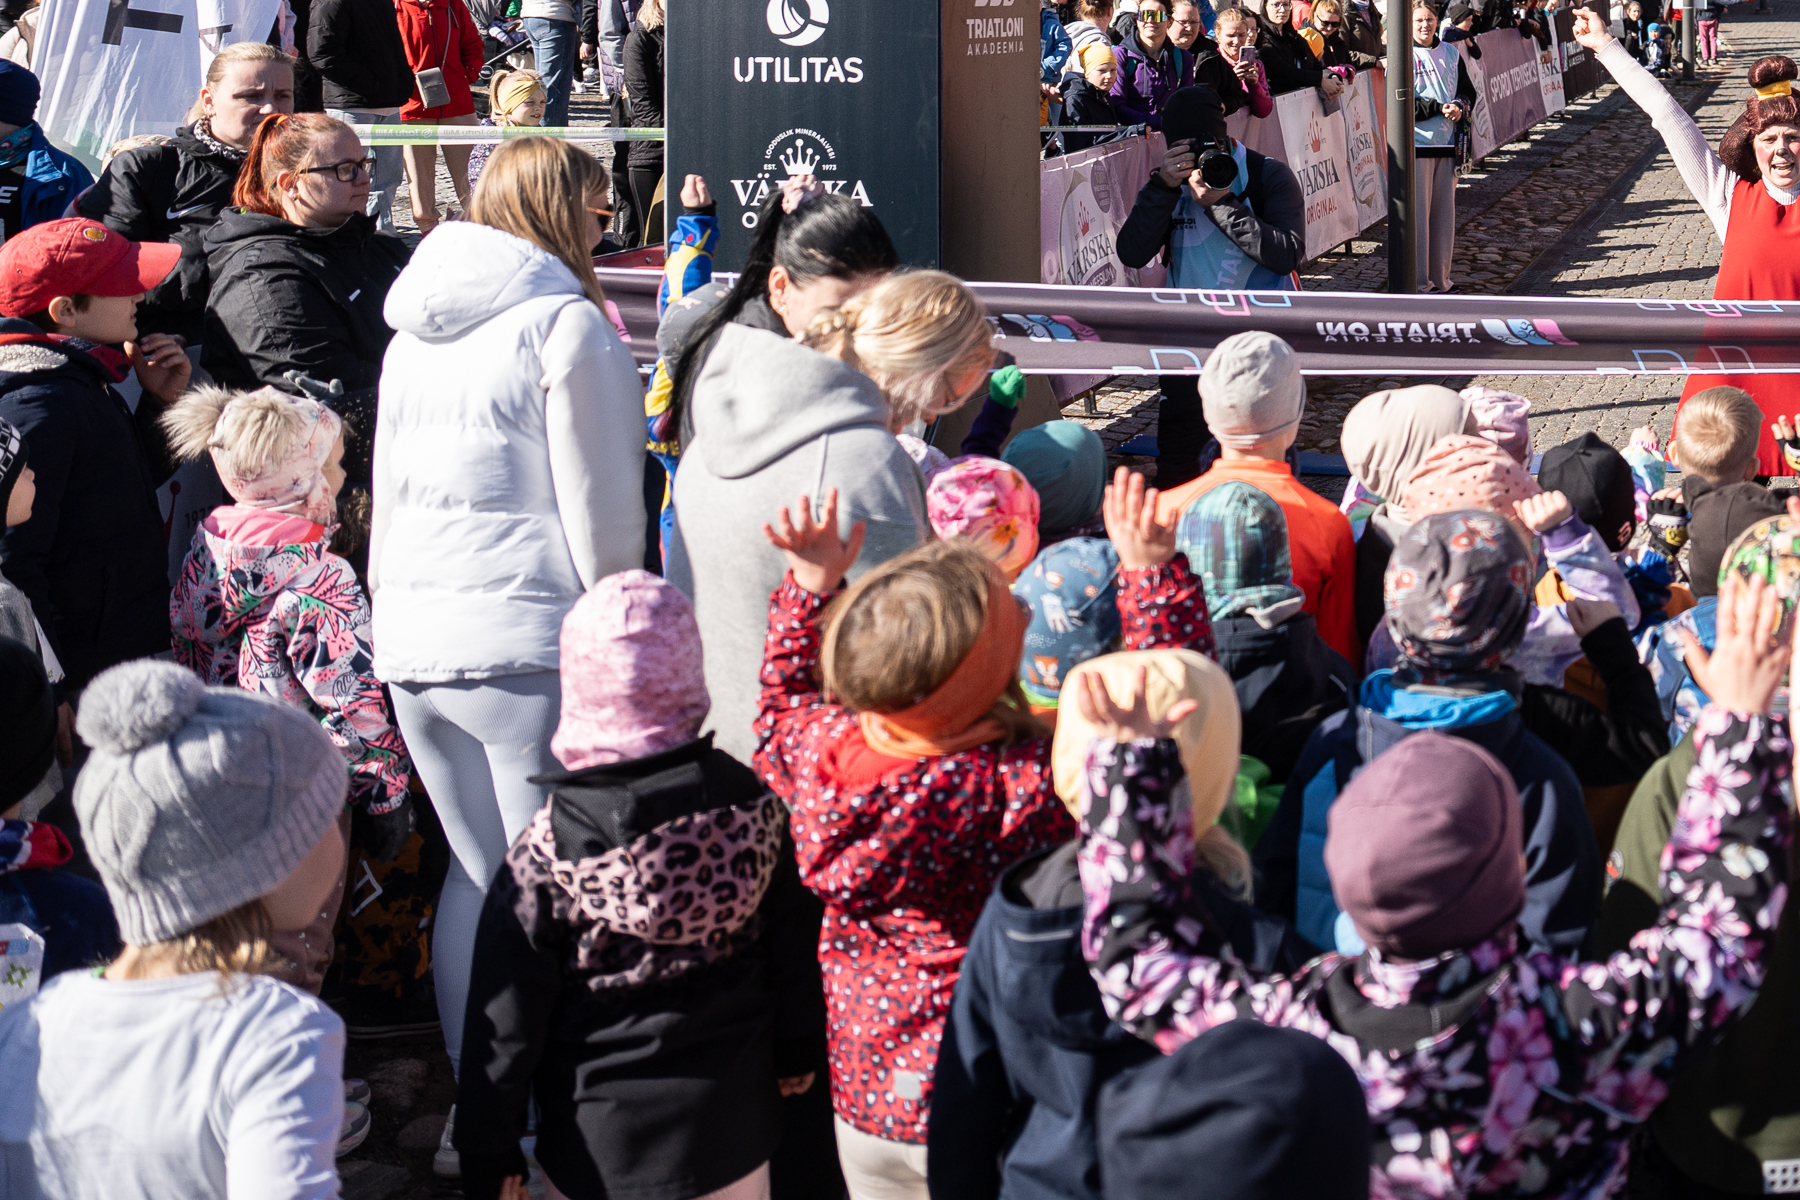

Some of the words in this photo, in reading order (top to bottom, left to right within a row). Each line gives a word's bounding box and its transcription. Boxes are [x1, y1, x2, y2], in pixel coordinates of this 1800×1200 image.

[967, 18, 1024, 39] TRIATLONI
[967, 44, 1024, 56] AKADEEMIA
[734, 57, 864, 83] UTILITAS
[764, 128, 794, 159] LOODUSLIK
[795, 128, 836, 159] MINERAALVESI
[763, 163, 777, 171] EST.
[1297, 156, 1341, 197] VÄRSKA
[730, 173, 874, 207] VÄKA
[1067, 233, 1115, 286] VÄRSKA
